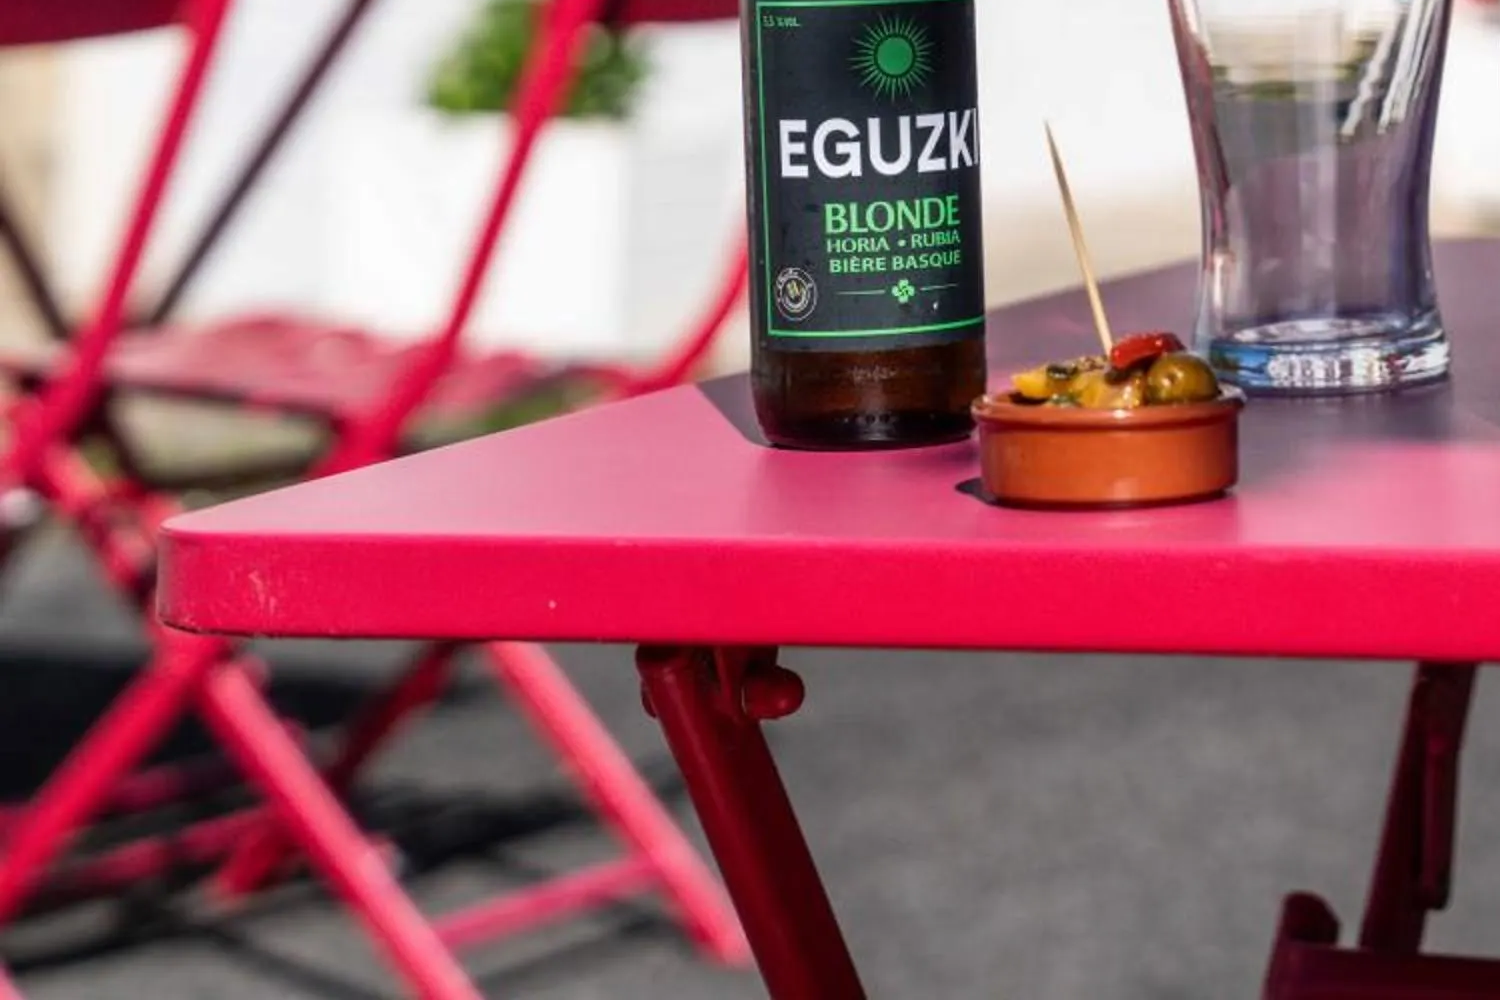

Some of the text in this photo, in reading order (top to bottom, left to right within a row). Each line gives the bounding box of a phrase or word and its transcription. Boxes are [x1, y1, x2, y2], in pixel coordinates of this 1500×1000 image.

[824, 194, 960, 234] BLONDE
[826, 229, 961, 254] HORIA RUBIA
[829, 249, 960, 273] BIÈRE BASQUE
